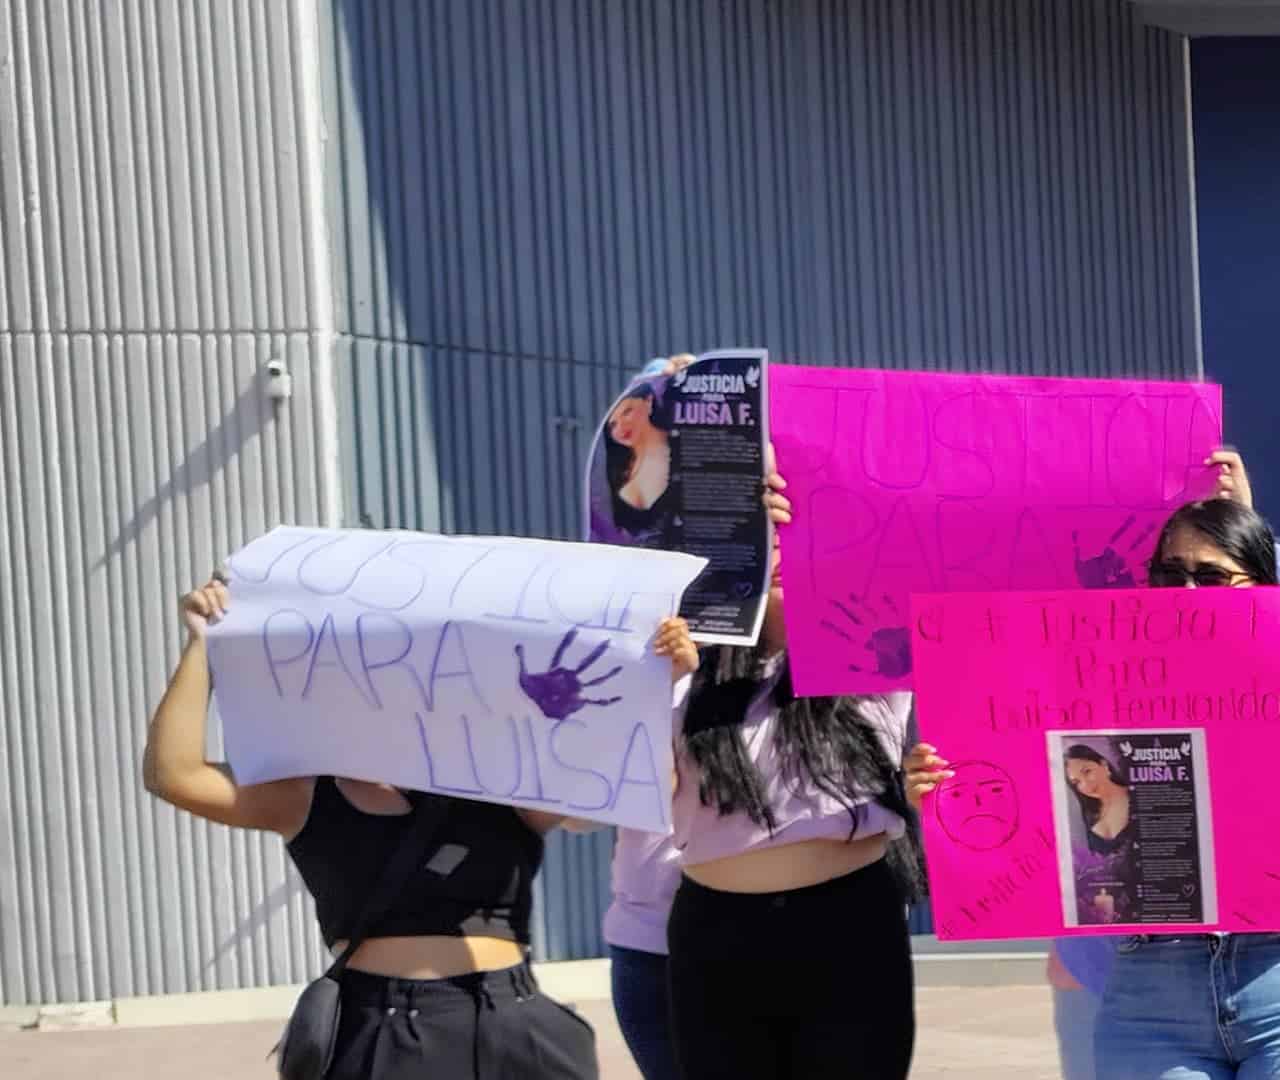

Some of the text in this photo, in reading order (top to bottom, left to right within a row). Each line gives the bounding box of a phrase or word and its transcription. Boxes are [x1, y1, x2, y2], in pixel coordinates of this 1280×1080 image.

[680, 373, 746, 393] JUSTICIA
[673, 402, 734, 425] LUISA
[262, 607, 492, 713] PARA
[1131, 748, 1181, 761] JUSTICIA
[414, 711, 669, 829] LUISA
[1129, 767, 1174, 782] LUISA
